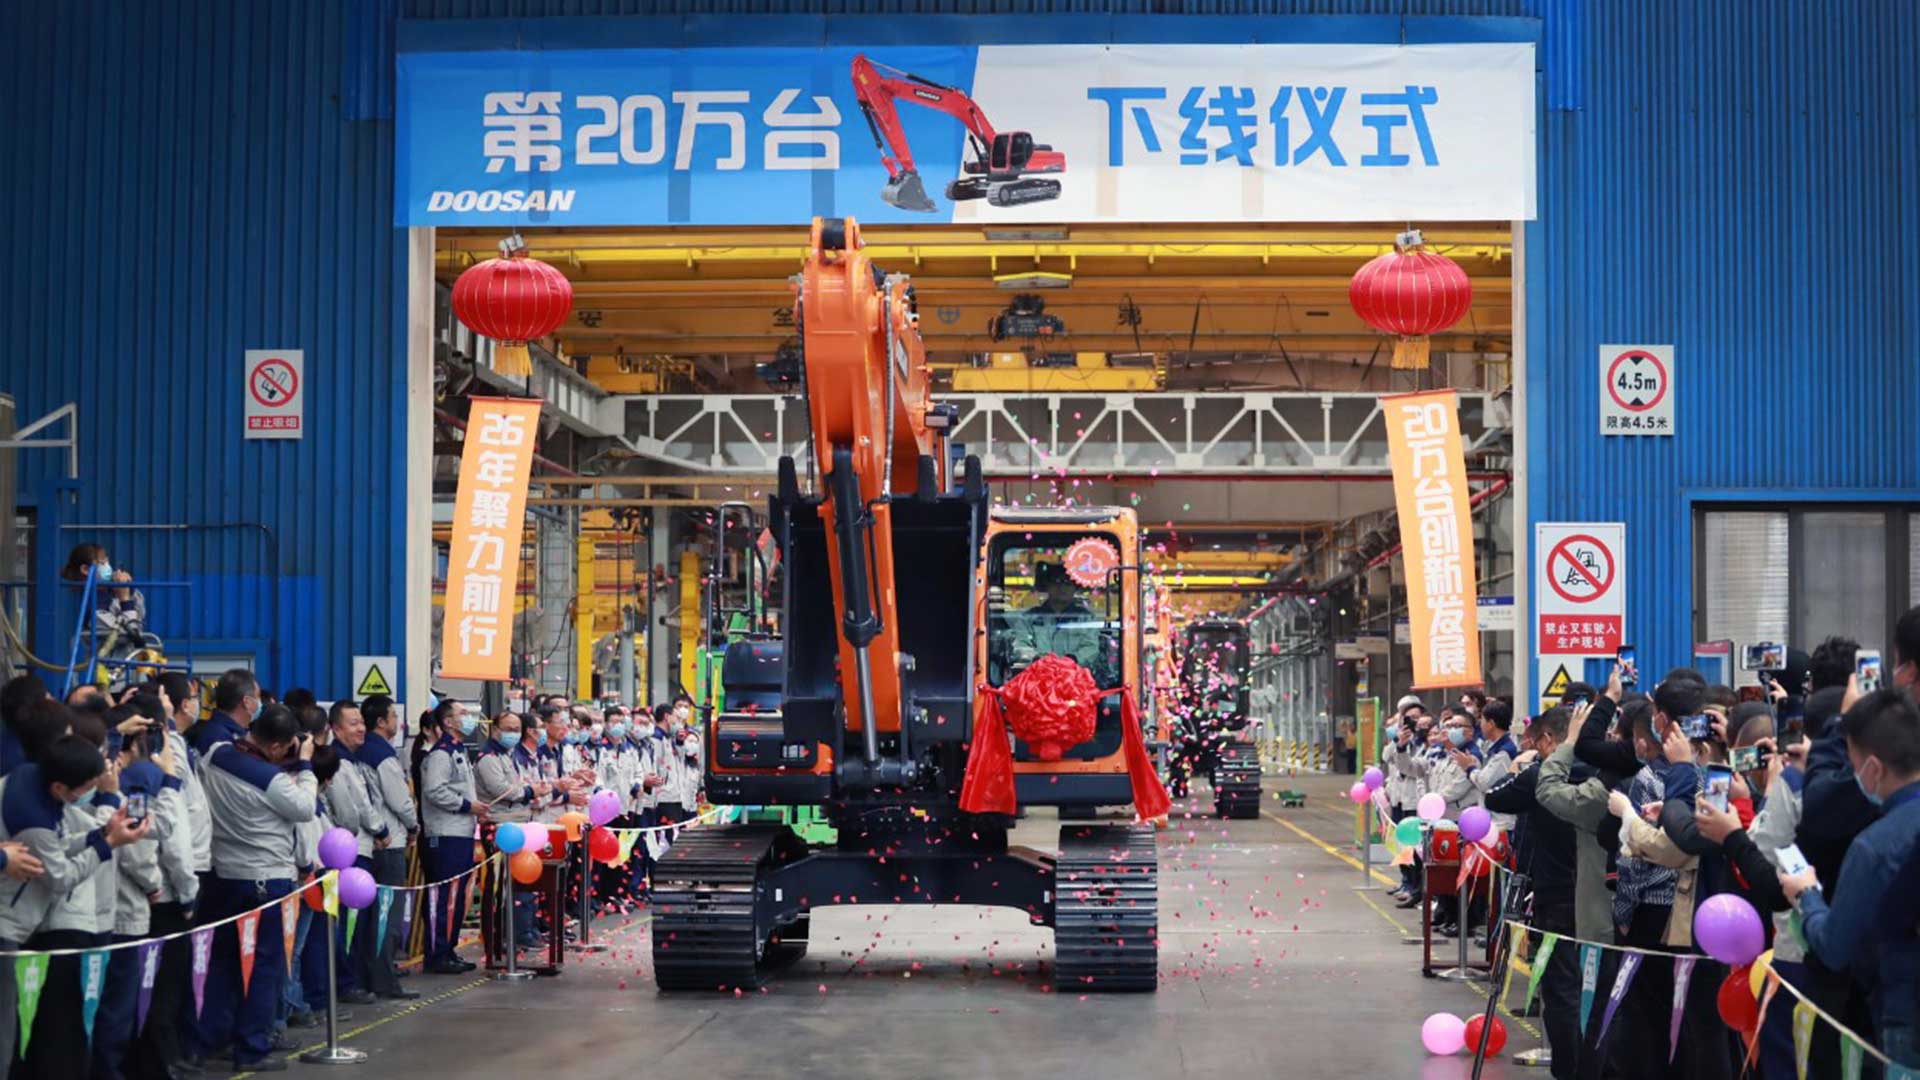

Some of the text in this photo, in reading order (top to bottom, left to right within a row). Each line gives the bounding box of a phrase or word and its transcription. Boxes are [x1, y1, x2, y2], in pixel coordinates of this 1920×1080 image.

[483, 85, 1440, 173] 第20万台 下线仪式
[427, 189, 575, 212] DOOSAN
[1617, 371, 1657, 391] 4.5m
[1606, 415, 1668, 430] 限高4.5米
[459, 412, 525, 657] 26年聚力前行
[1401, 402, 1467, 677] 20万台创新发展
[1544, 621, 1617, 635] 禁止叉车驶入
[1557, 635, 1606, 649] 生产现场
